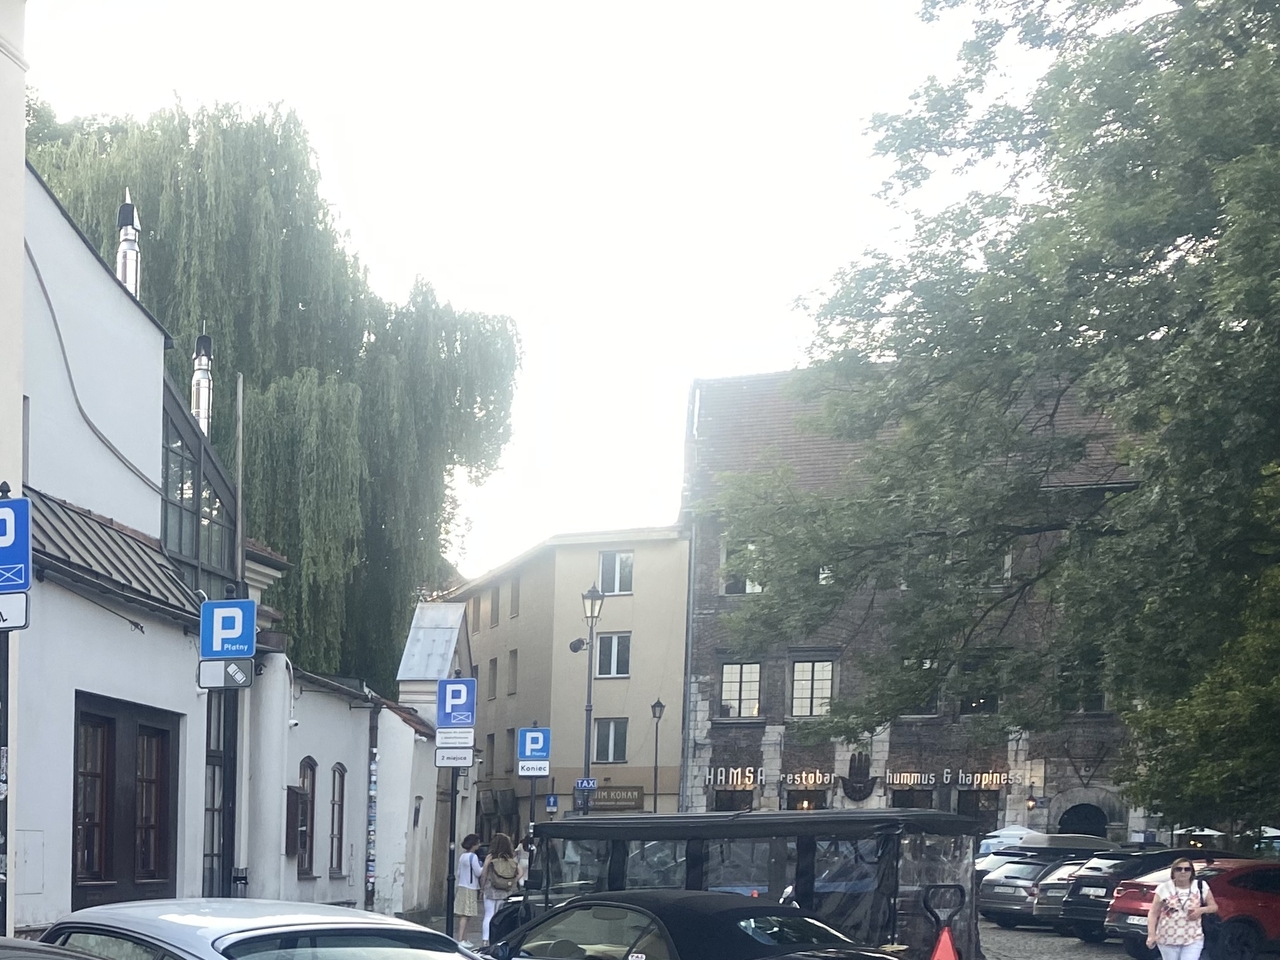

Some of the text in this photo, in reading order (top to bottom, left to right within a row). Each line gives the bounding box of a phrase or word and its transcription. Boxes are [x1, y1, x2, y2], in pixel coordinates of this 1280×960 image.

[212, 607, 243, 651] P
[223, 643, 249, 652] Płatny
[445, 683, 468, 713] P
[525, 731, 544, 756] P
[520, 764, 548, 772] Koniec
[705, 766, 1023, 790] HAMSA restobar hummus & happiness
[577, 779, 597, 788] TAXI
